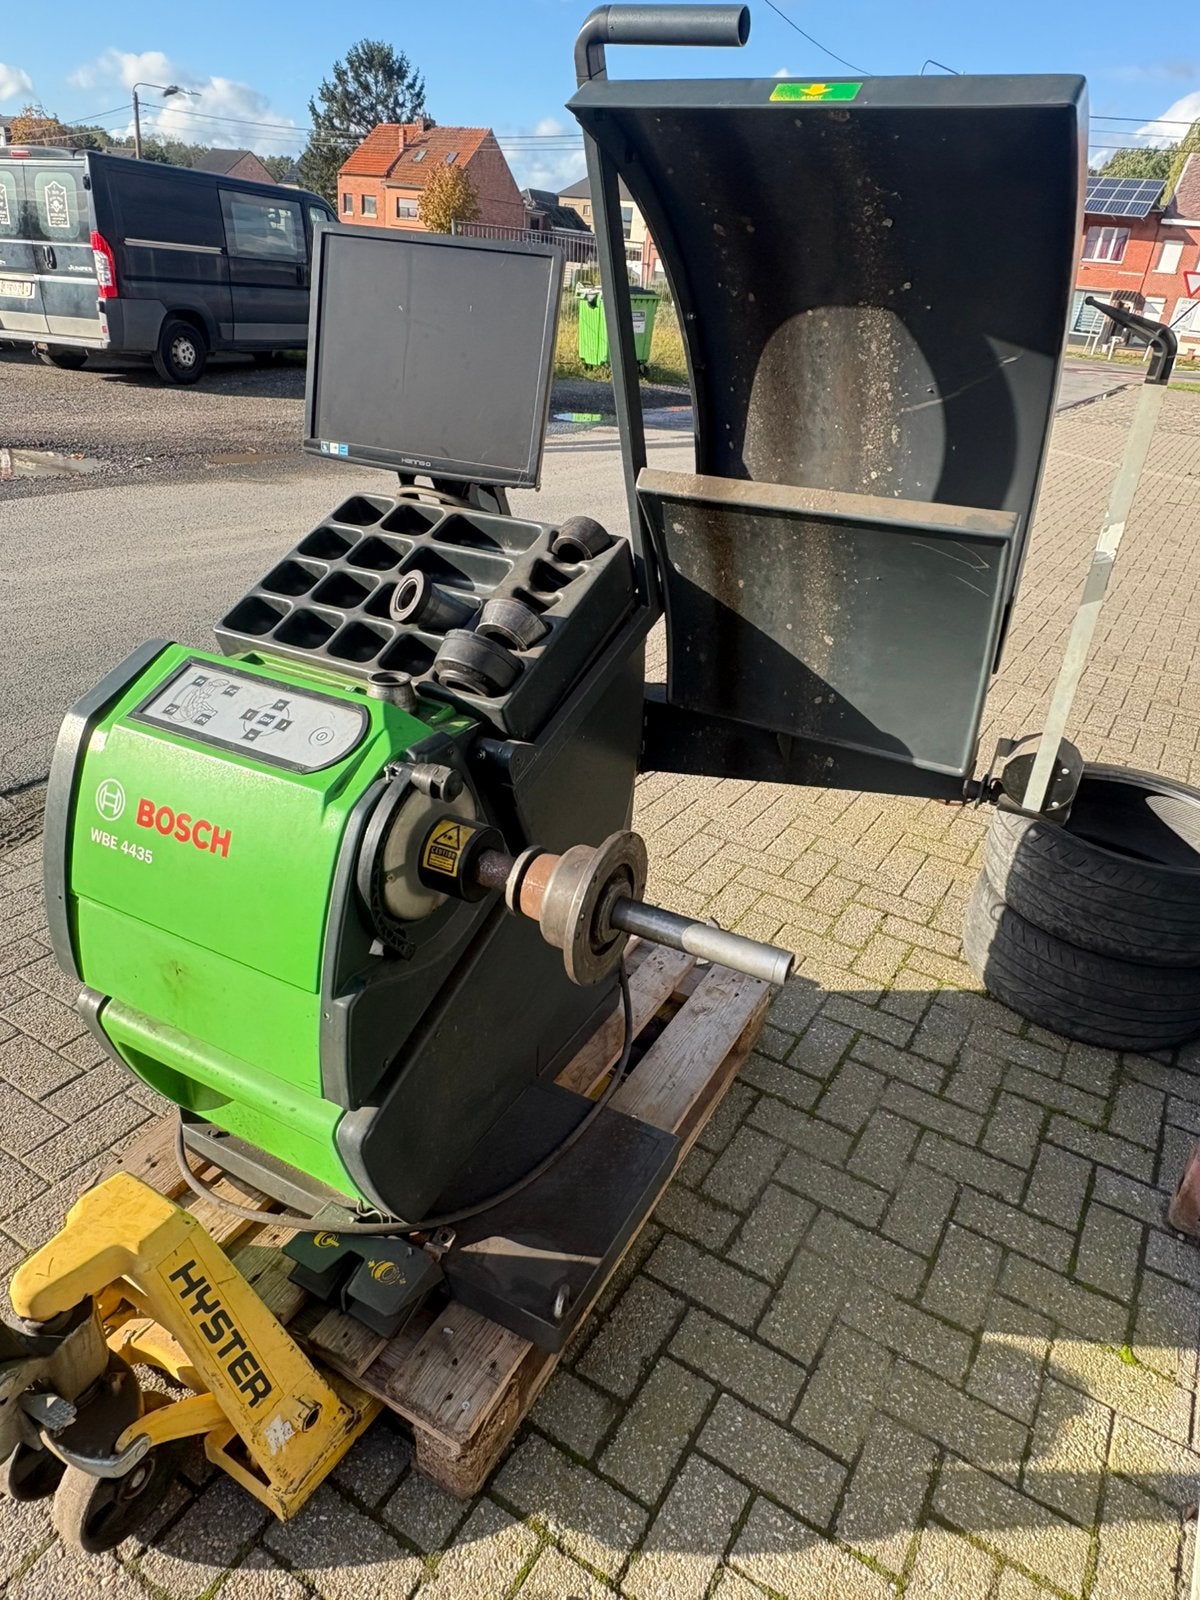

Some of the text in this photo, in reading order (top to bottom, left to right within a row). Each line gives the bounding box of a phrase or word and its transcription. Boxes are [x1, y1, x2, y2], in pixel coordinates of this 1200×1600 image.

[91, 827, 153, 864] WBE 4435
[136, 798, 232, 858] BOSCH
[431, 846, 456, 859] CAUTION
[168, 1259, 272, 1408] HYSTER
